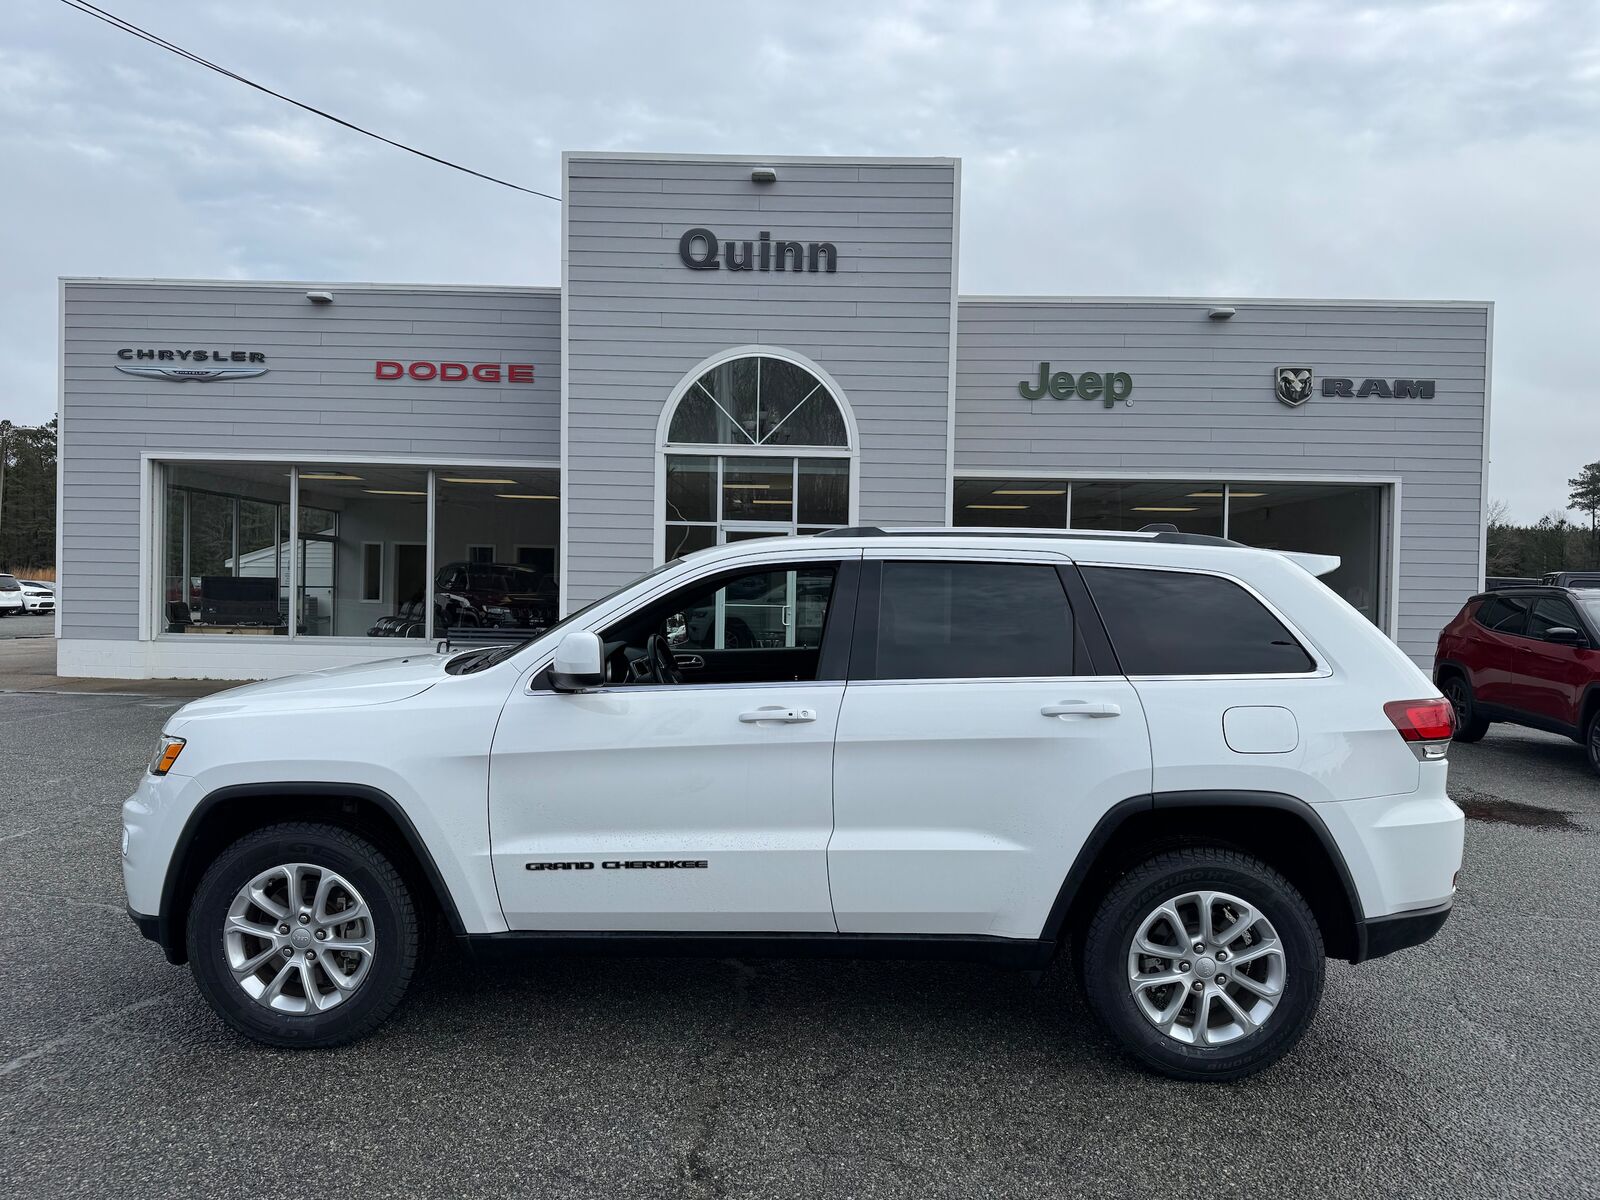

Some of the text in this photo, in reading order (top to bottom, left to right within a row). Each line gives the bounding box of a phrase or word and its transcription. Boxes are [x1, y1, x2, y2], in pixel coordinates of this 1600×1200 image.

[679, 228, 837, 273] Quinn
[117, 348, 266, 363] CHRYSLER
[375, 360, 535, 384] DODGE
[1018, 361, 1133, 409] Jeep
[1322, 378, 1436, 399] RAM
[525, 860, 709, 871] GRAND CHEROKEE
